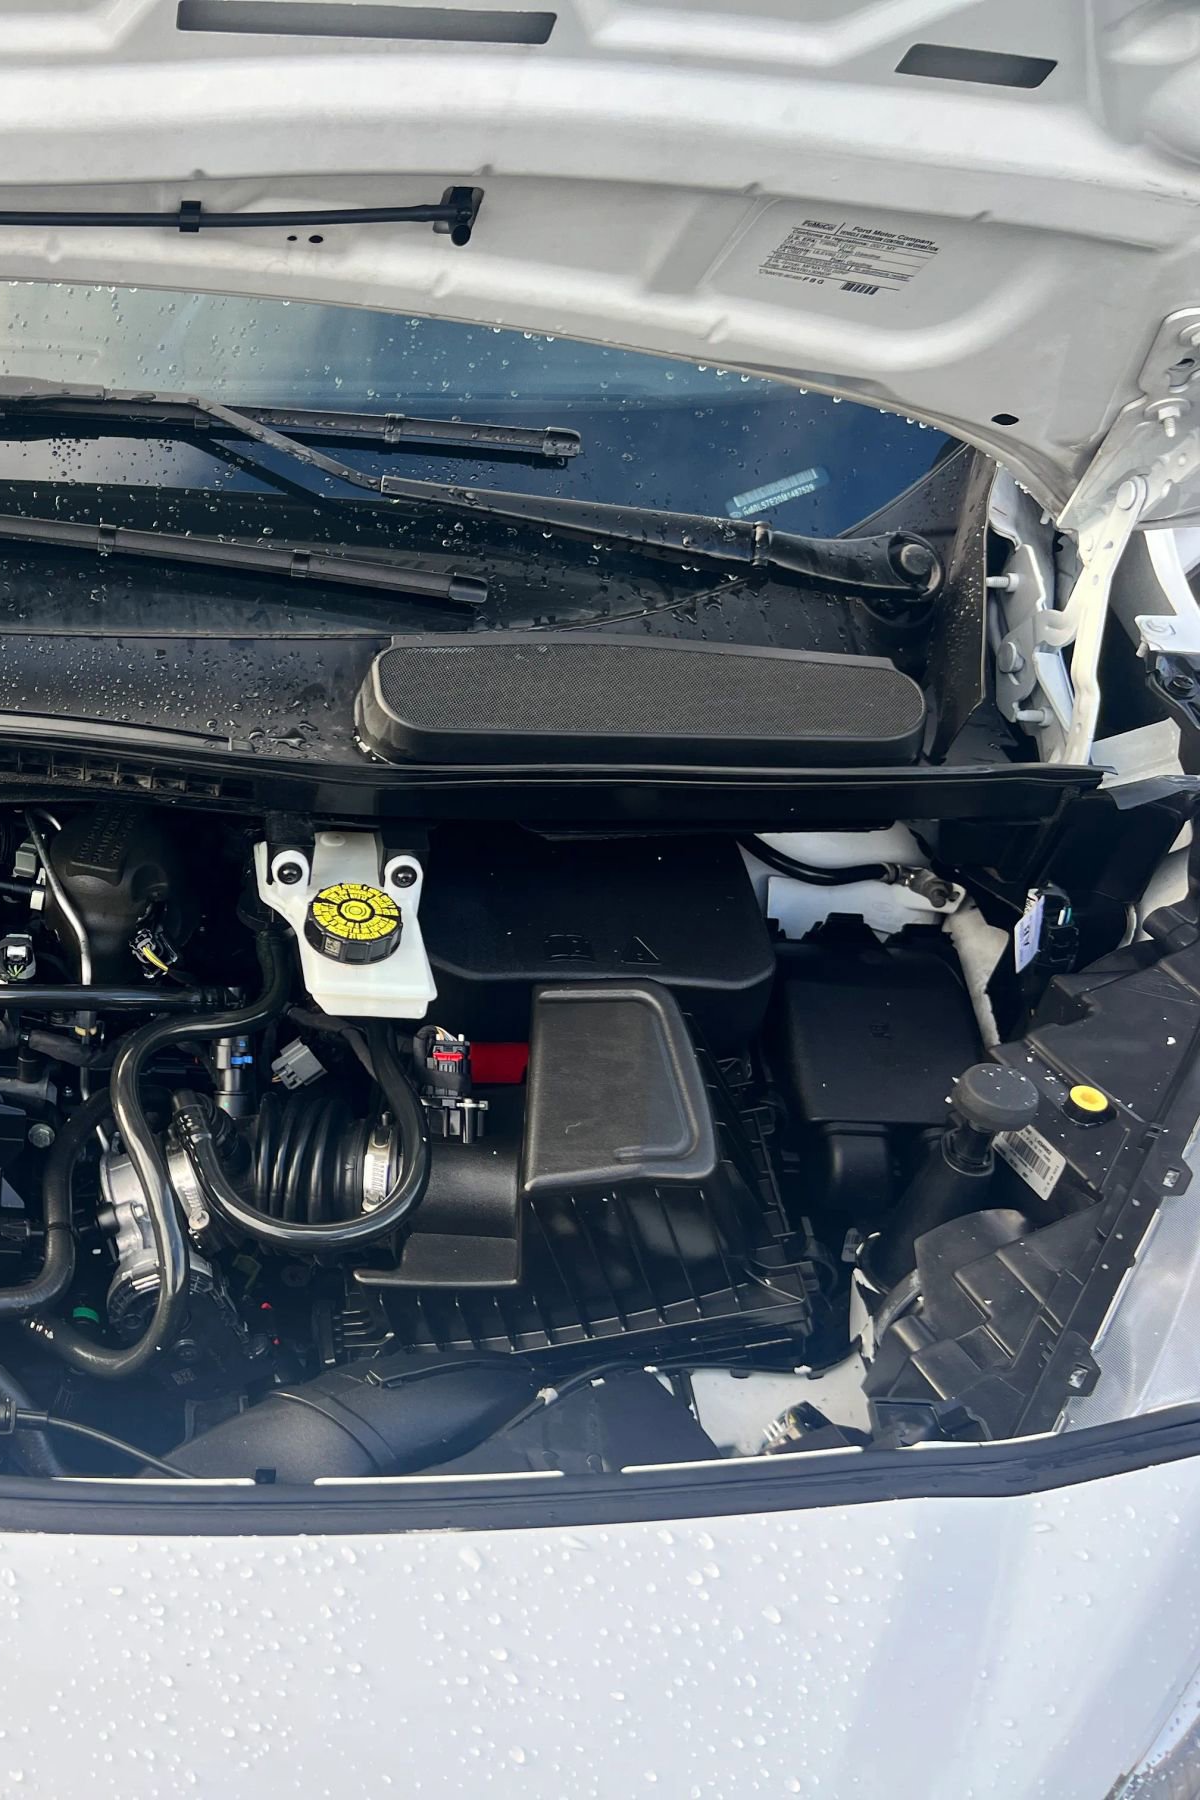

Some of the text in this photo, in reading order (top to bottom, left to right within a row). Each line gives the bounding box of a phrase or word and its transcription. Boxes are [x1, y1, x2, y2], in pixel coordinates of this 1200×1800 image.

[852, 225, 936, 246] Ford Motor Company
